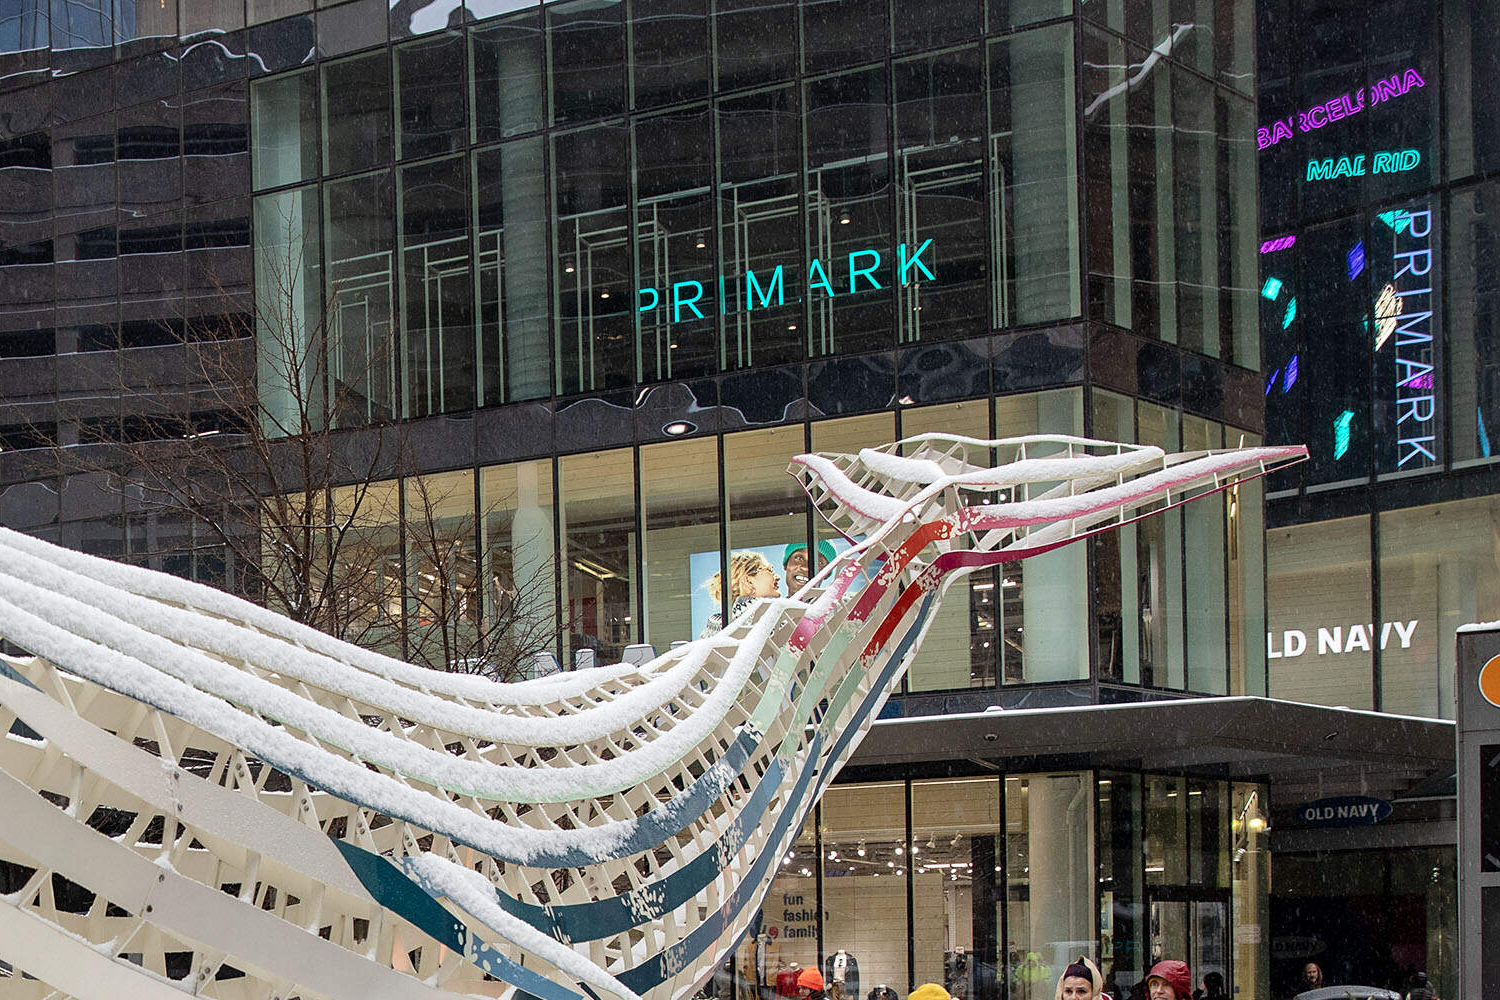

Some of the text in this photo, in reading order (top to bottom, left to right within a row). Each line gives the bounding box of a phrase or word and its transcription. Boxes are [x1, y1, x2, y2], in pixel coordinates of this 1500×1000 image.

[1257, 66, 1426, 151] BARCELONA
[637, 238, 937, 323] PRIMARK
[1393, 209, 1437, 468] PRIMARK
[1267, 620, 1419, 659] LD NAVY
[1304, 803, 1380, 821] OLD NAVY
[783, 893, 804, 906] fun
